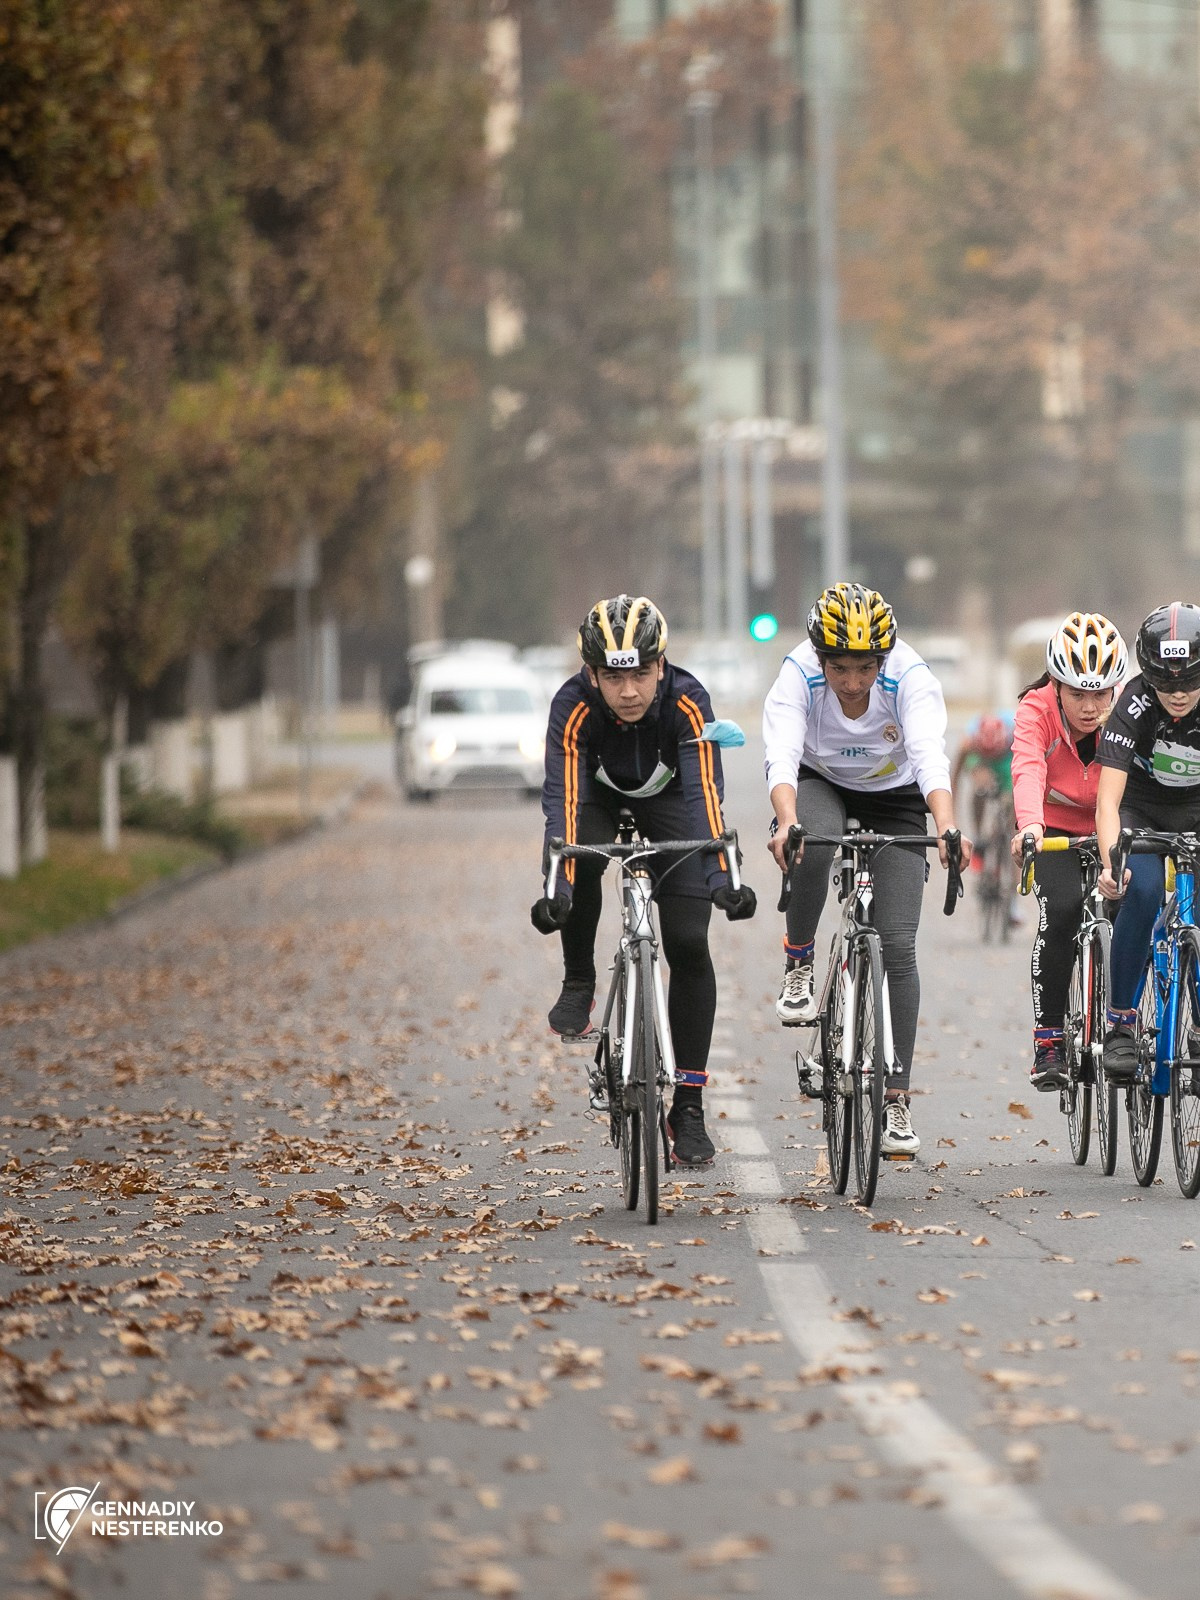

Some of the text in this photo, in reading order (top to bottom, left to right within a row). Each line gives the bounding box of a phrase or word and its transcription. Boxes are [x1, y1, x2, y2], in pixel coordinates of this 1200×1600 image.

[1163, 647, 1186, 656] 050
[611, 656, 635, 666] 069
[1080, 680, 1101, 689] 049
